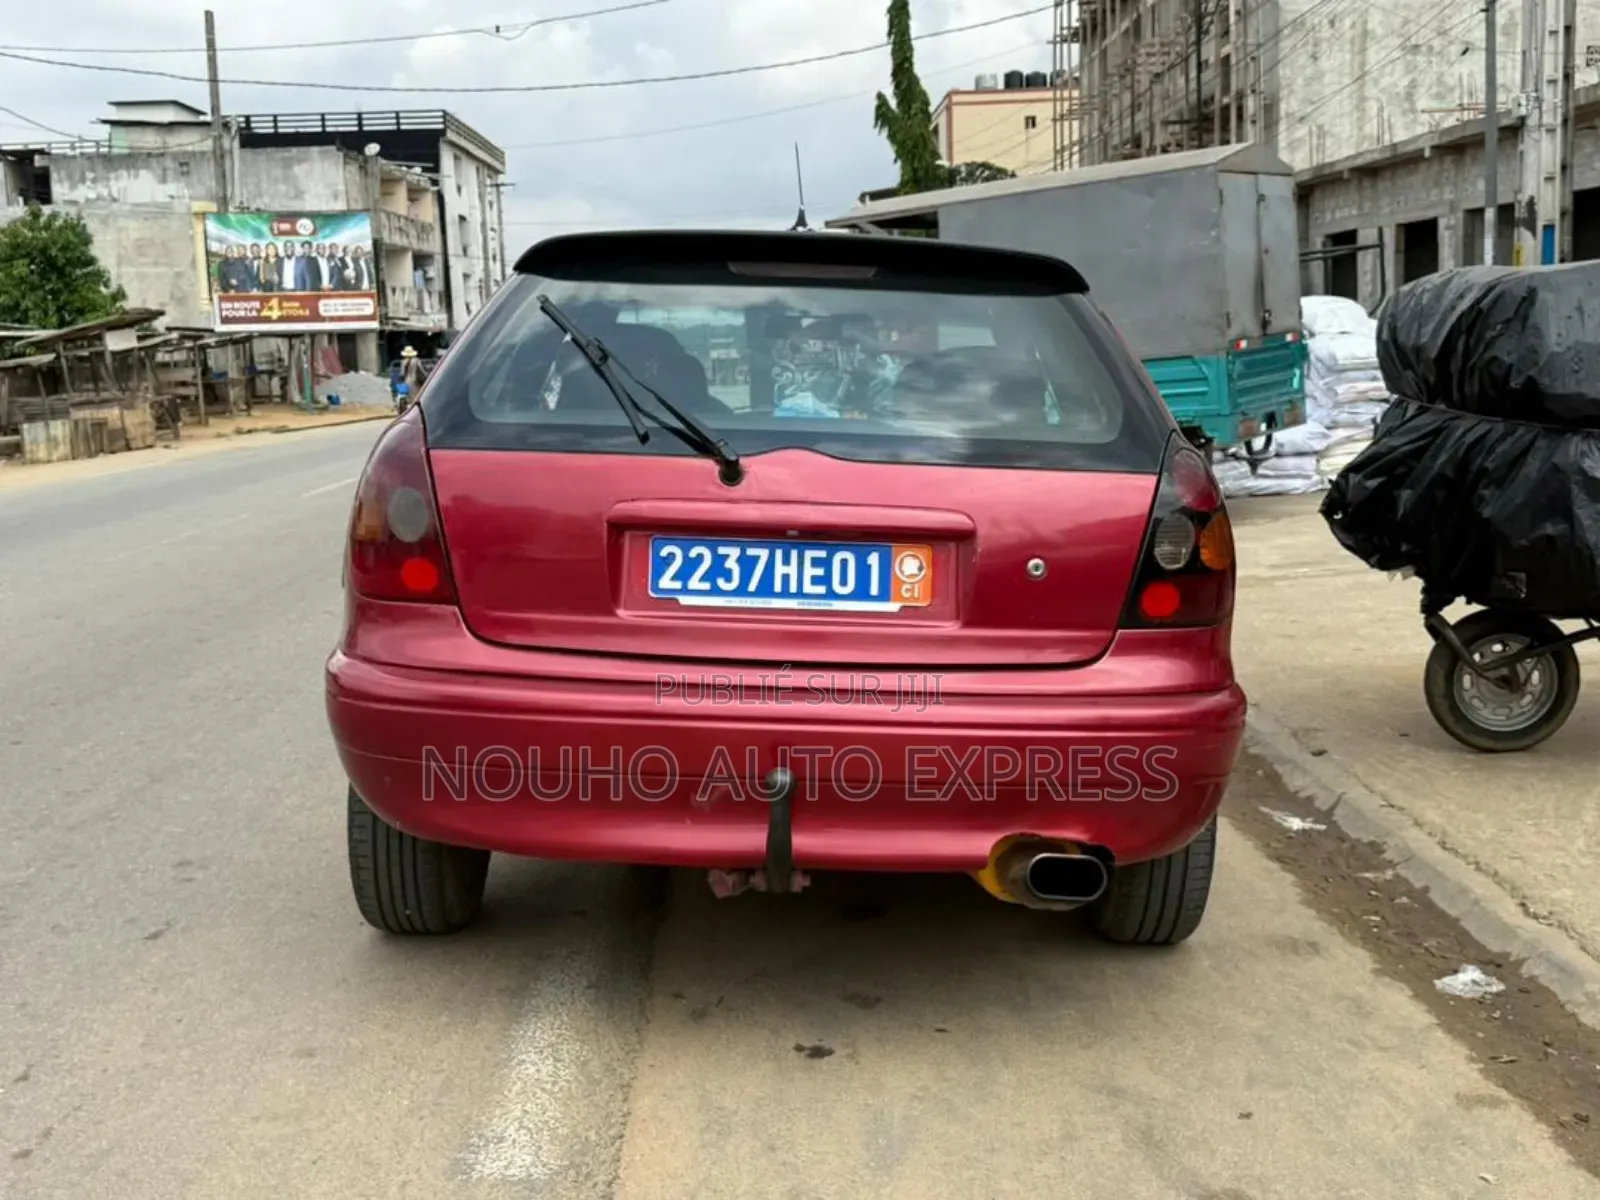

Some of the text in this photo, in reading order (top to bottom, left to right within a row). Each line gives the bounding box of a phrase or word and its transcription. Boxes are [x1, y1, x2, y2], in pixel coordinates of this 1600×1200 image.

[222, 309, 258, 317] POUR LA
[260, 297, 282, 320] 4
[657, 544, 881, 596] 2237HE01
[900, 584, 921, 599] CI
